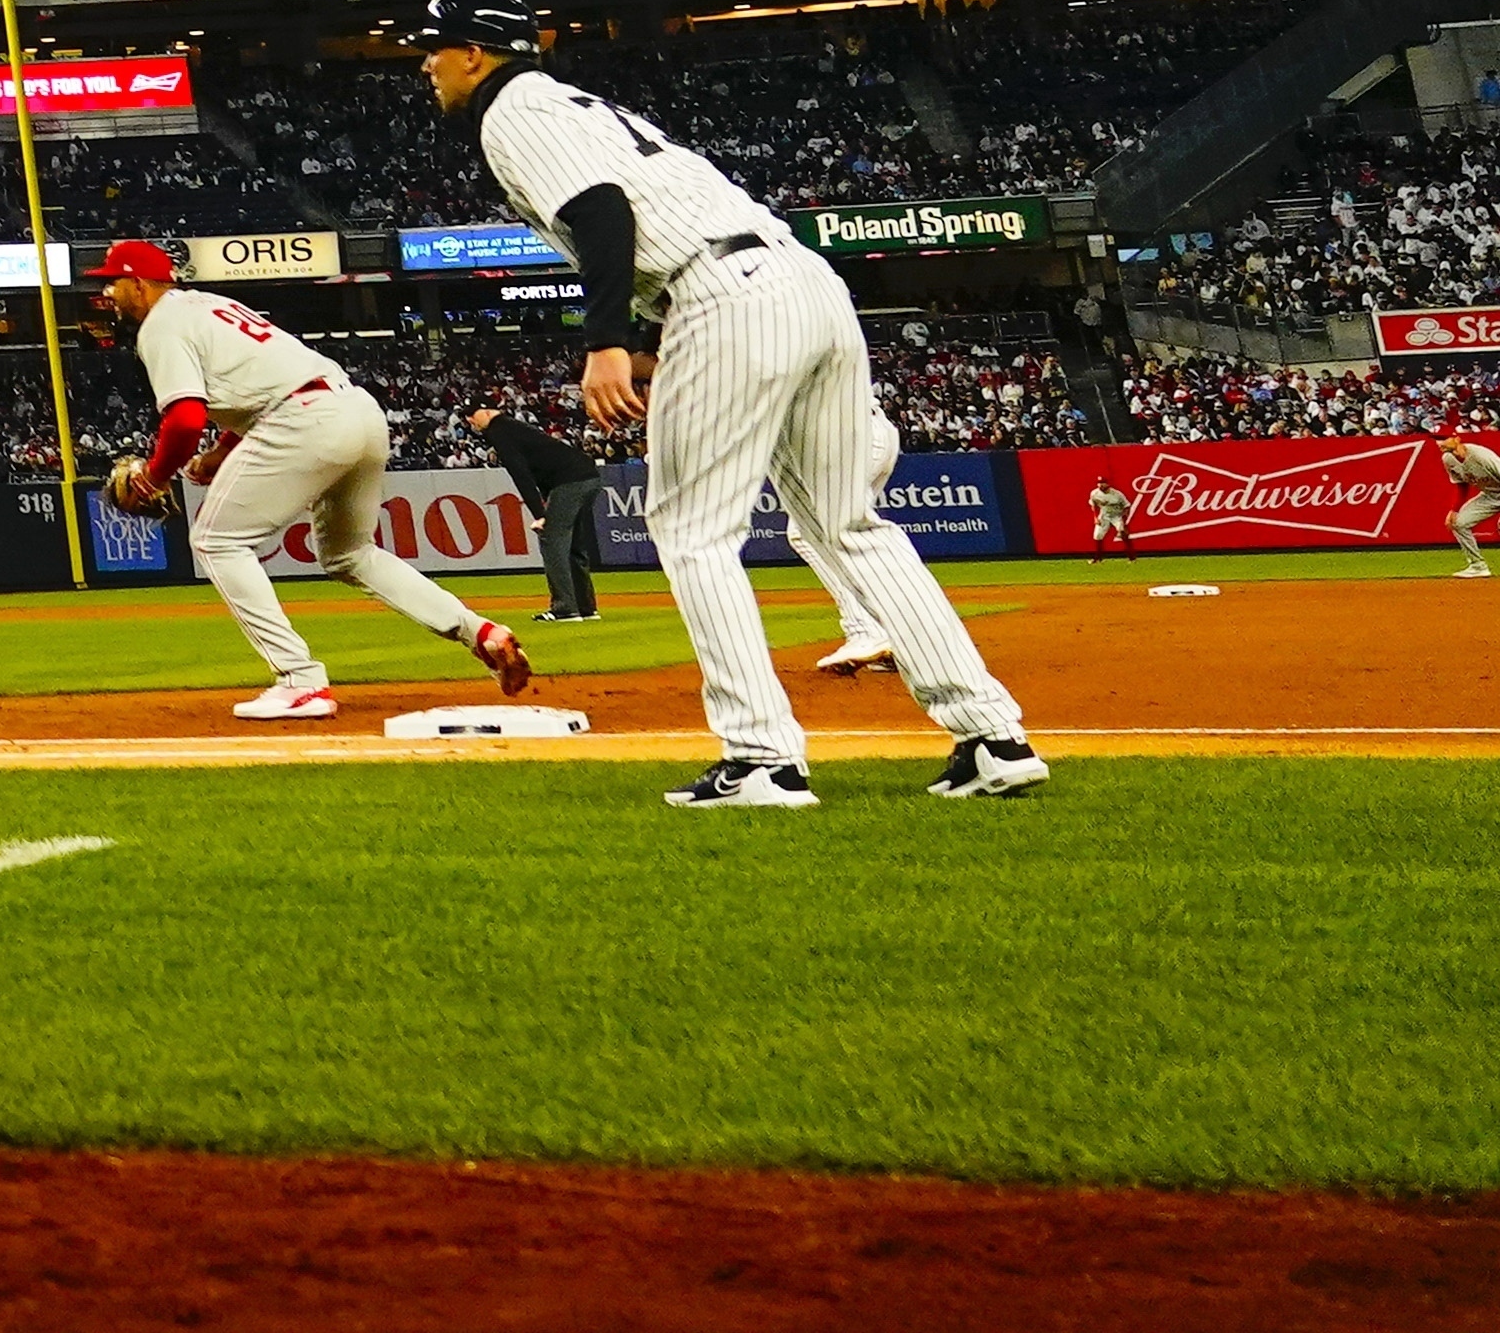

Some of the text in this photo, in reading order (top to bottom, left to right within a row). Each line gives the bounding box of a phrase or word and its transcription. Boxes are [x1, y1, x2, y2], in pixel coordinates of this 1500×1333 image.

[3, 78, 50, 97] BD'S
[52, 77, 84, 95] FOR
[84, 75, 122, 94] YOU.
[816, 206, 1023, 247] Poland Spring
[222, 236, 313, 265] ORIS
[467, 237, 490, 248] STAY
[491, 237, 502, 247] AT
[502, 237, 523, 247] THE
[467, 247, 499, 257] MUSIC
[500, 247, 522, 256] AND
[500, 284, 558, 300] SPORTS
[18, 492, 55, 514] 318
[1132, 473, 1399, 517] Budweiser
[44, 512, 56, 523] FT
[93, 515, 158, 542] YORK
[935, 518, 989, 533] Health
[105, 538, 153, 561] LIFE
